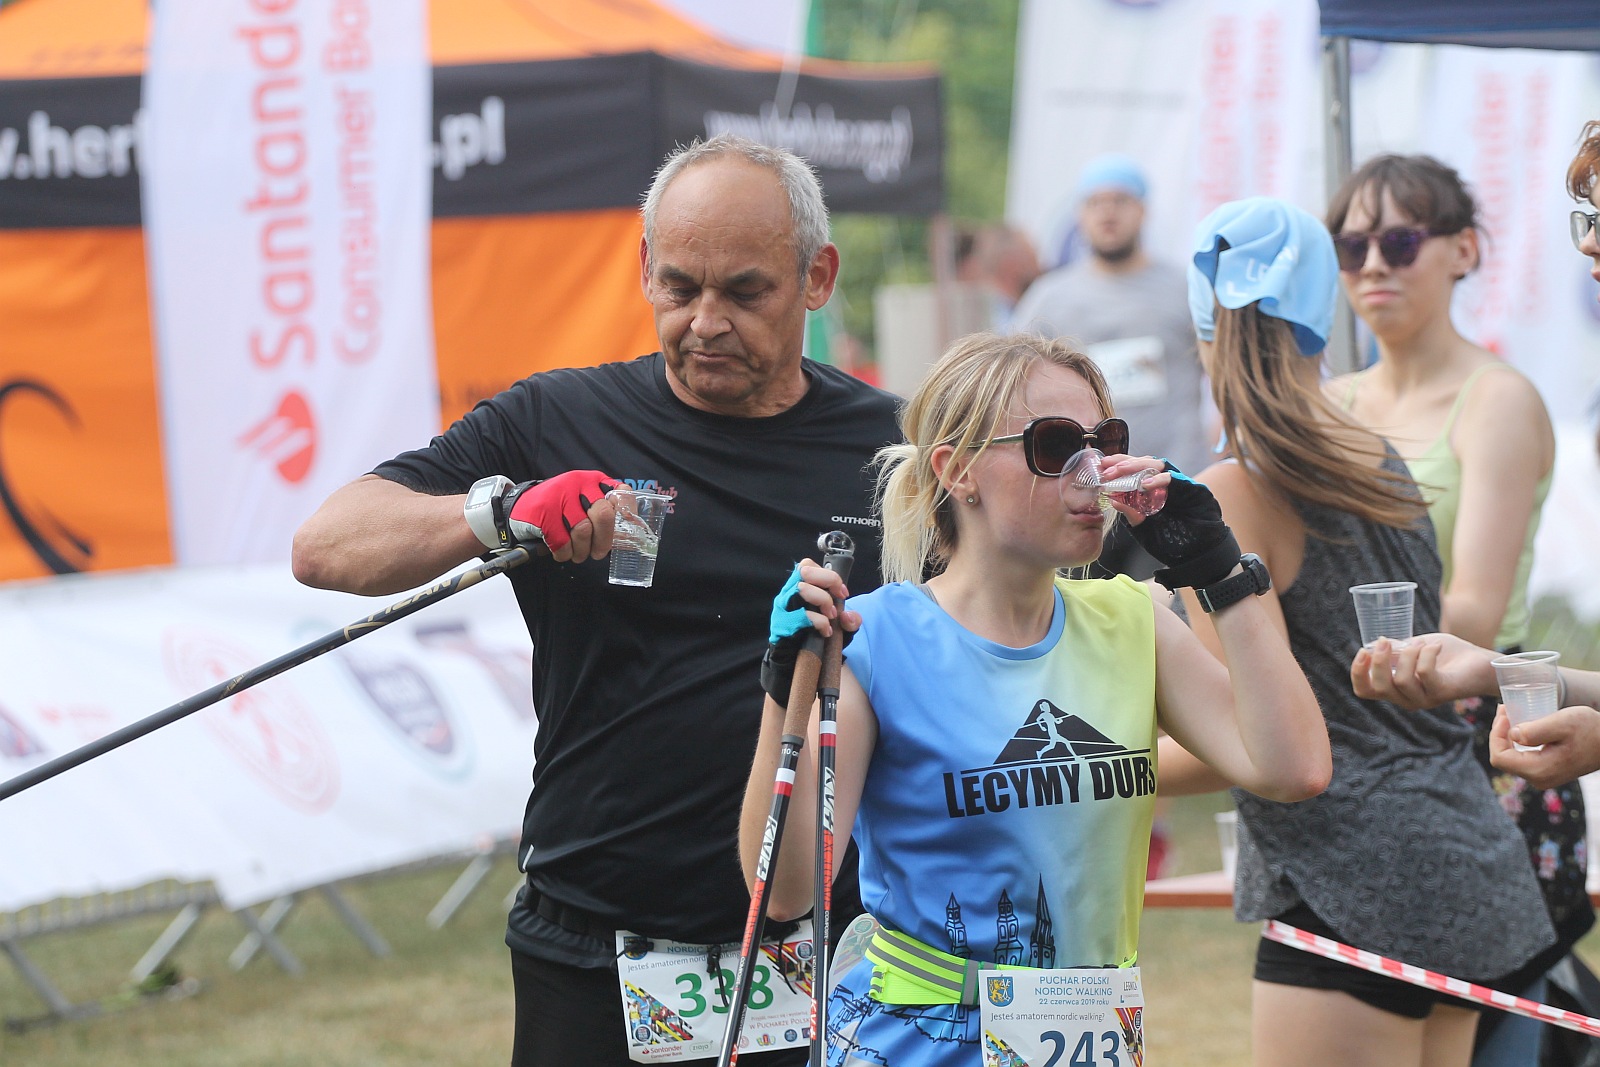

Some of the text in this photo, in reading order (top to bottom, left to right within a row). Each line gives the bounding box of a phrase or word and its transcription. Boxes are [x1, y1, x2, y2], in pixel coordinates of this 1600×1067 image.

[831, 515, 881, 527] OUTHORN
[942, 764, 1080, 819] LECYMY
[651, 958, 689, 969] amatorem
[689, 954, 708, 963] nord
[1039, 976, 1110, 985] PUCHAR POLSKI
[1034, 987, 1113, 996] NORDIC WALKING
[990, 1012, 1106, 1022] Jesteś amatorem nordic walking?
[1039, 1030, 1120, 1067] 243
